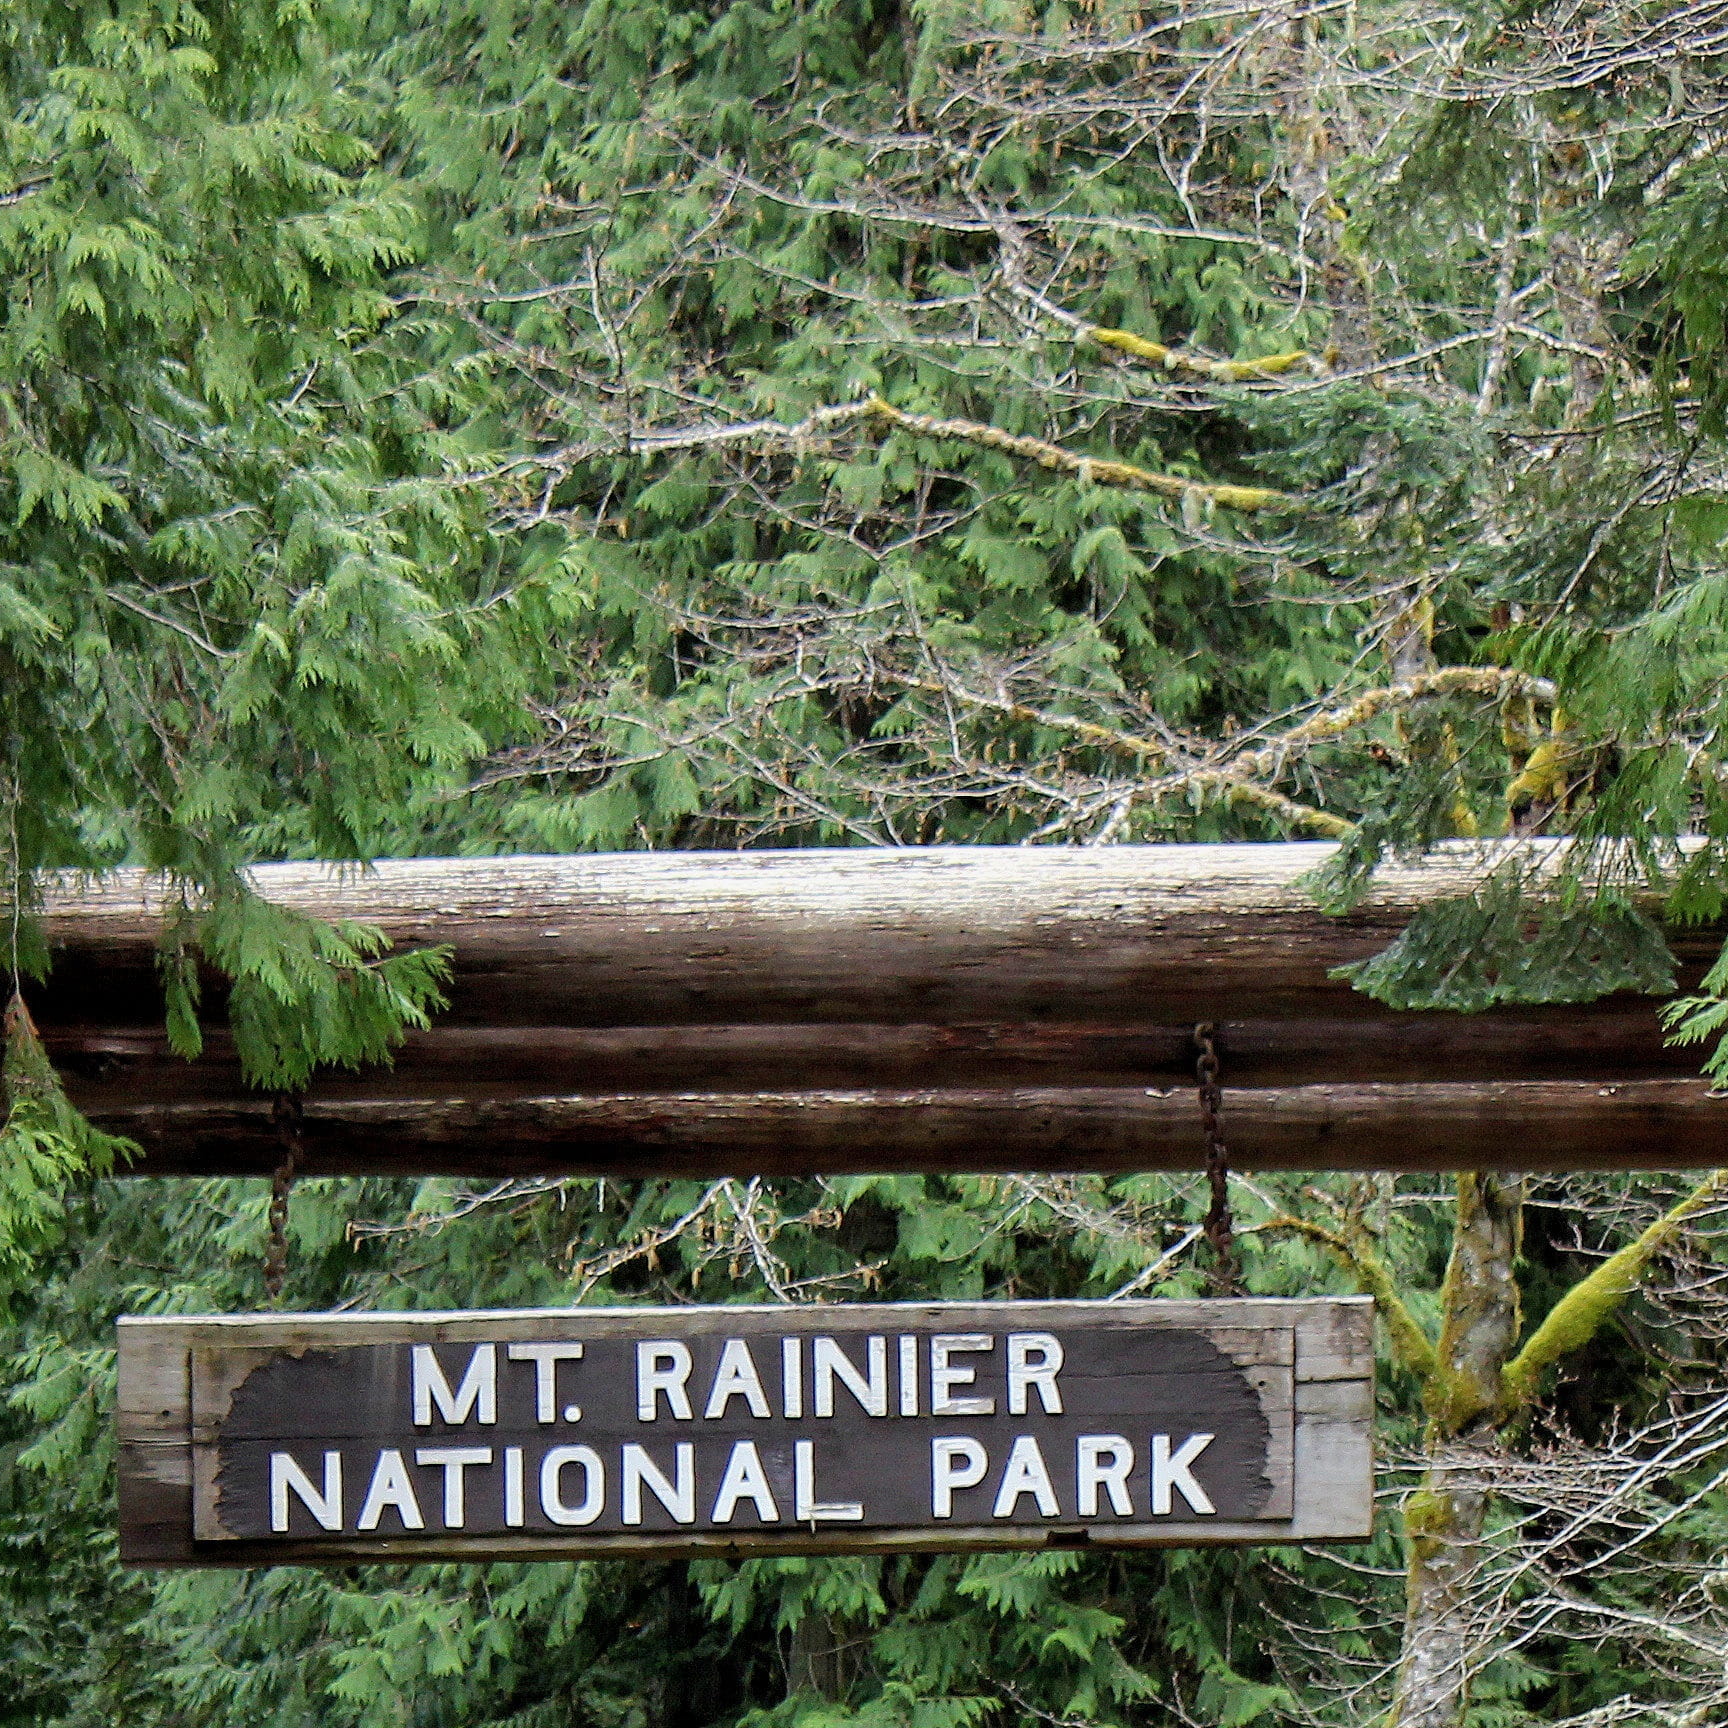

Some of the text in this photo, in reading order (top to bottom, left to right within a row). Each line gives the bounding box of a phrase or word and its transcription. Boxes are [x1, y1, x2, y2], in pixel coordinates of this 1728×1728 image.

[411, 1331, 1066, 1426] MT. RAINIER
[269, 1432, 1218, 1533] NATIONAL PARK
